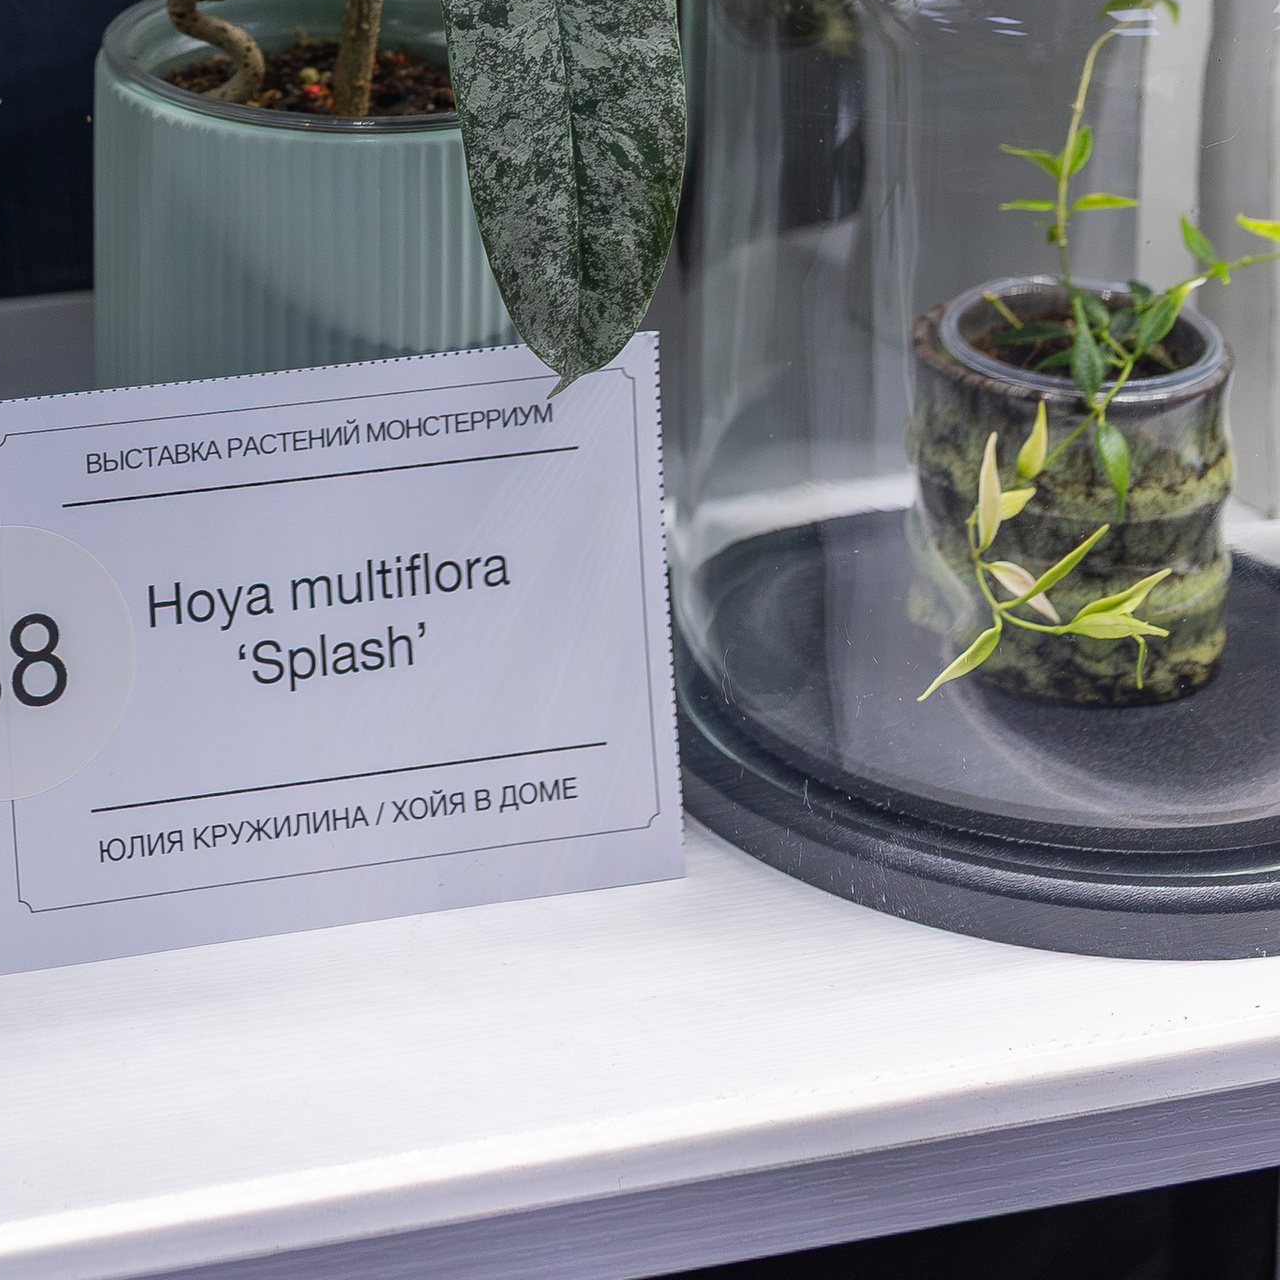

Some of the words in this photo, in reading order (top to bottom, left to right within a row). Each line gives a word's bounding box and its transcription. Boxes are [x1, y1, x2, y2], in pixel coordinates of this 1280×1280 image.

[85, 439, 222, 475] ВЫСТАВКА
[227, 418, 361, 459] РАСТЕНИЙ
[366, 403, 554, 444] МОНСТЕРРИУМ
[148, 581, 274, 631] Hoya
[290, 552, 511, 611] multiflora
[238, 621, 426, 693] ‘Splash’
[99, 829, 184, 863] ЮЛИЯ
[192, 805, 370, 850] КРУЖИЛИНА
[392, 789, 466, 824] ХОЙЯ
[475, 788, 492, 812] В
[498, 776, 579, 814] ДОМЕ
